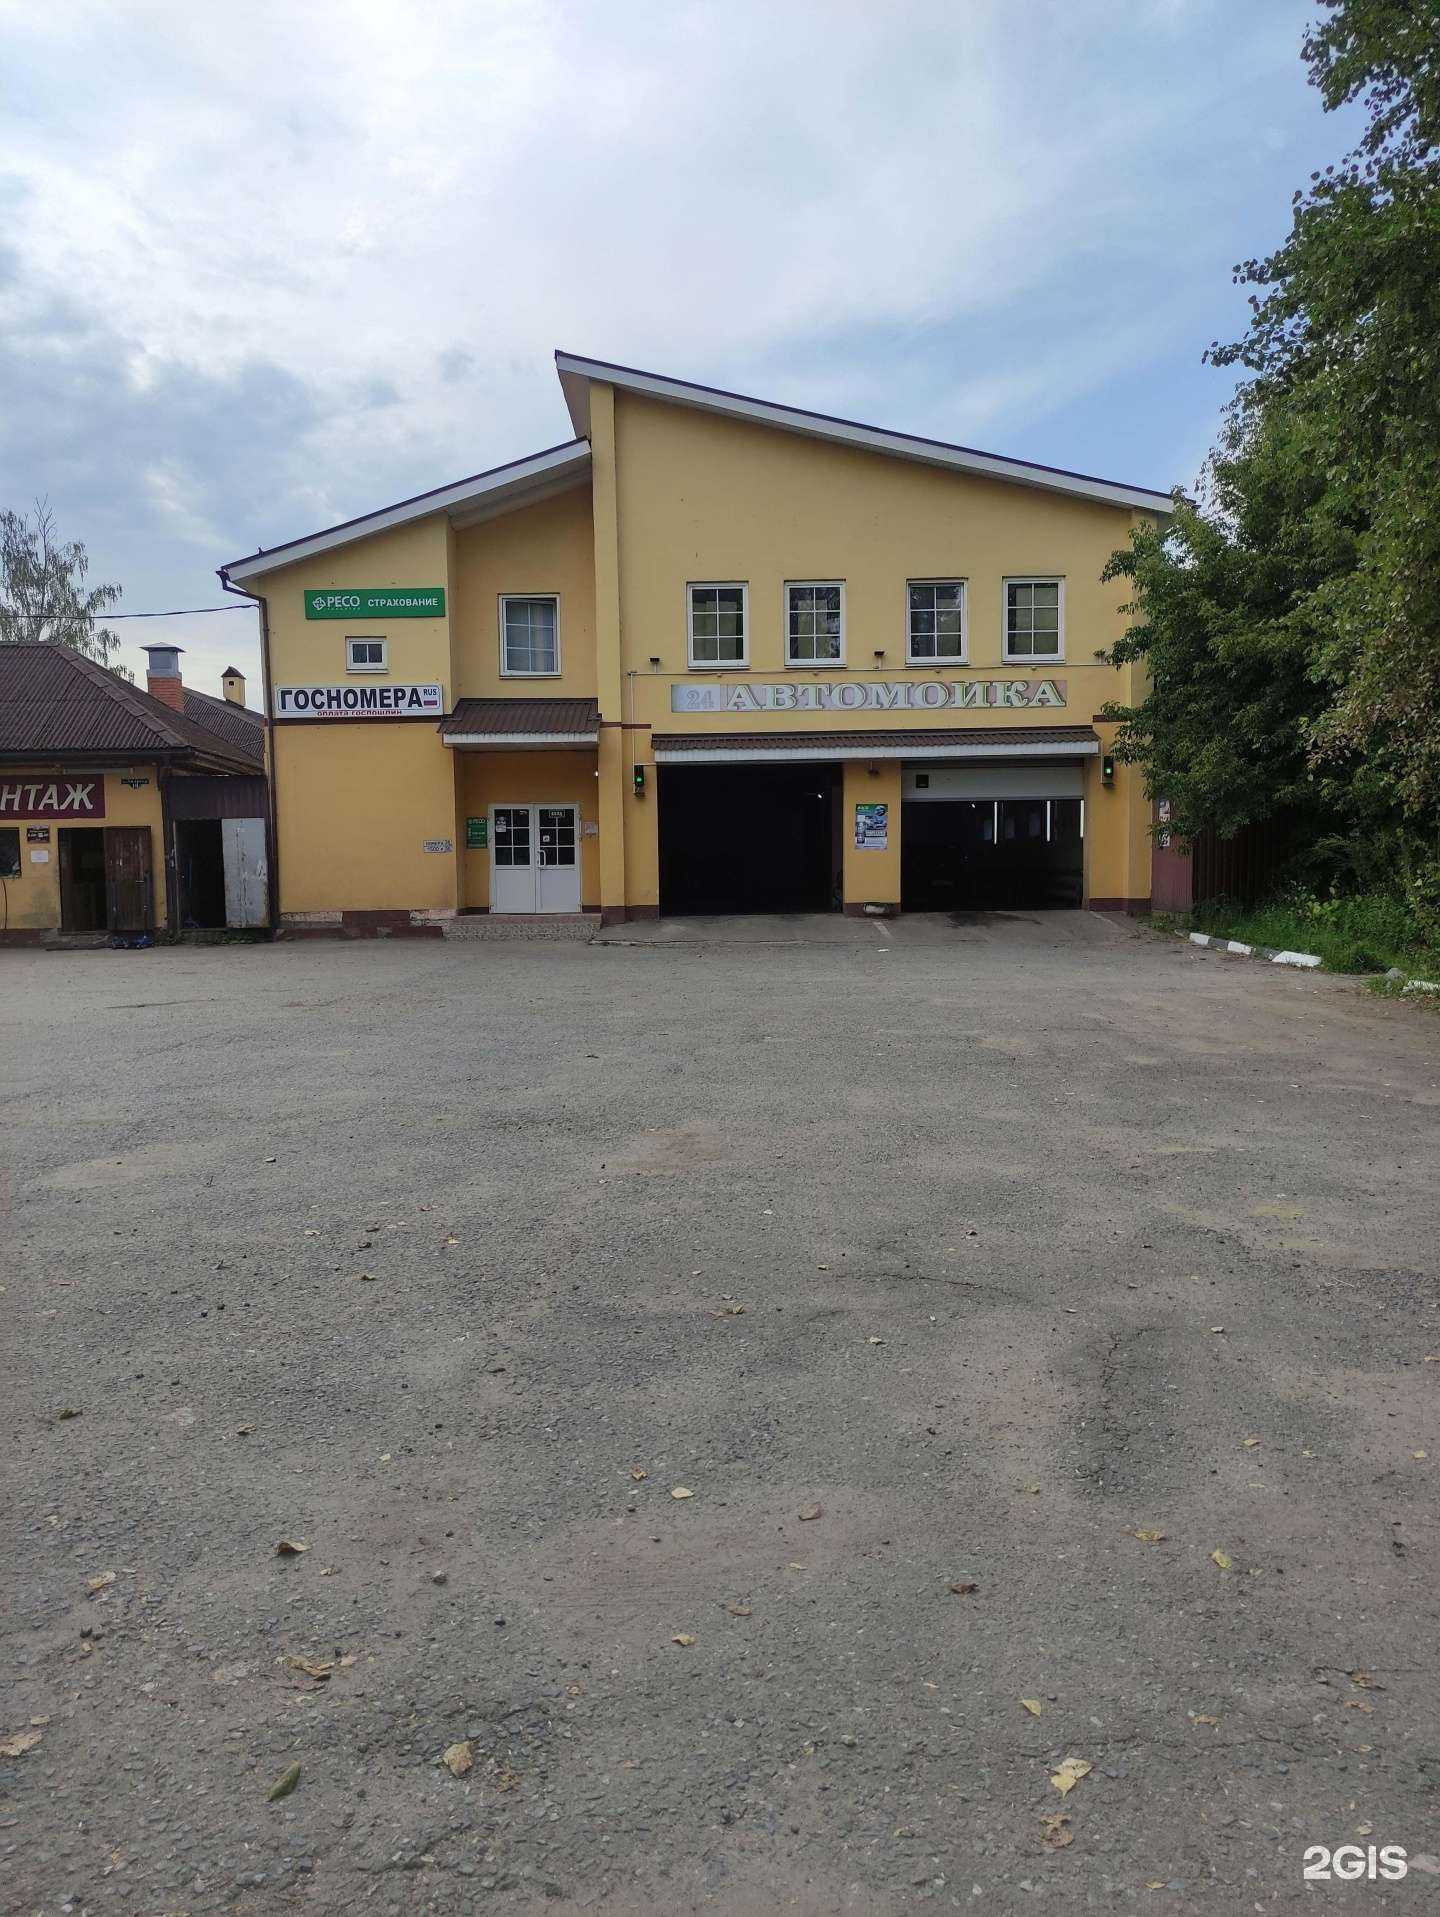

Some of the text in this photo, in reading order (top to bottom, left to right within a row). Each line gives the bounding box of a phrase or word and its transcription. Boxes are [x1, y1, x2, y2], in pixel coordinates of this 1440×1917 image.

[327, 596, 439, 607] РЕСО СТРАХОВАНИЕ
[280, 688, 423, 710] ГОСНОМЕРА
[423, 688, 437, 696] RUS
[686, 690, 714, 709] 24
[0, 784, 96, 811] НТАЖ
